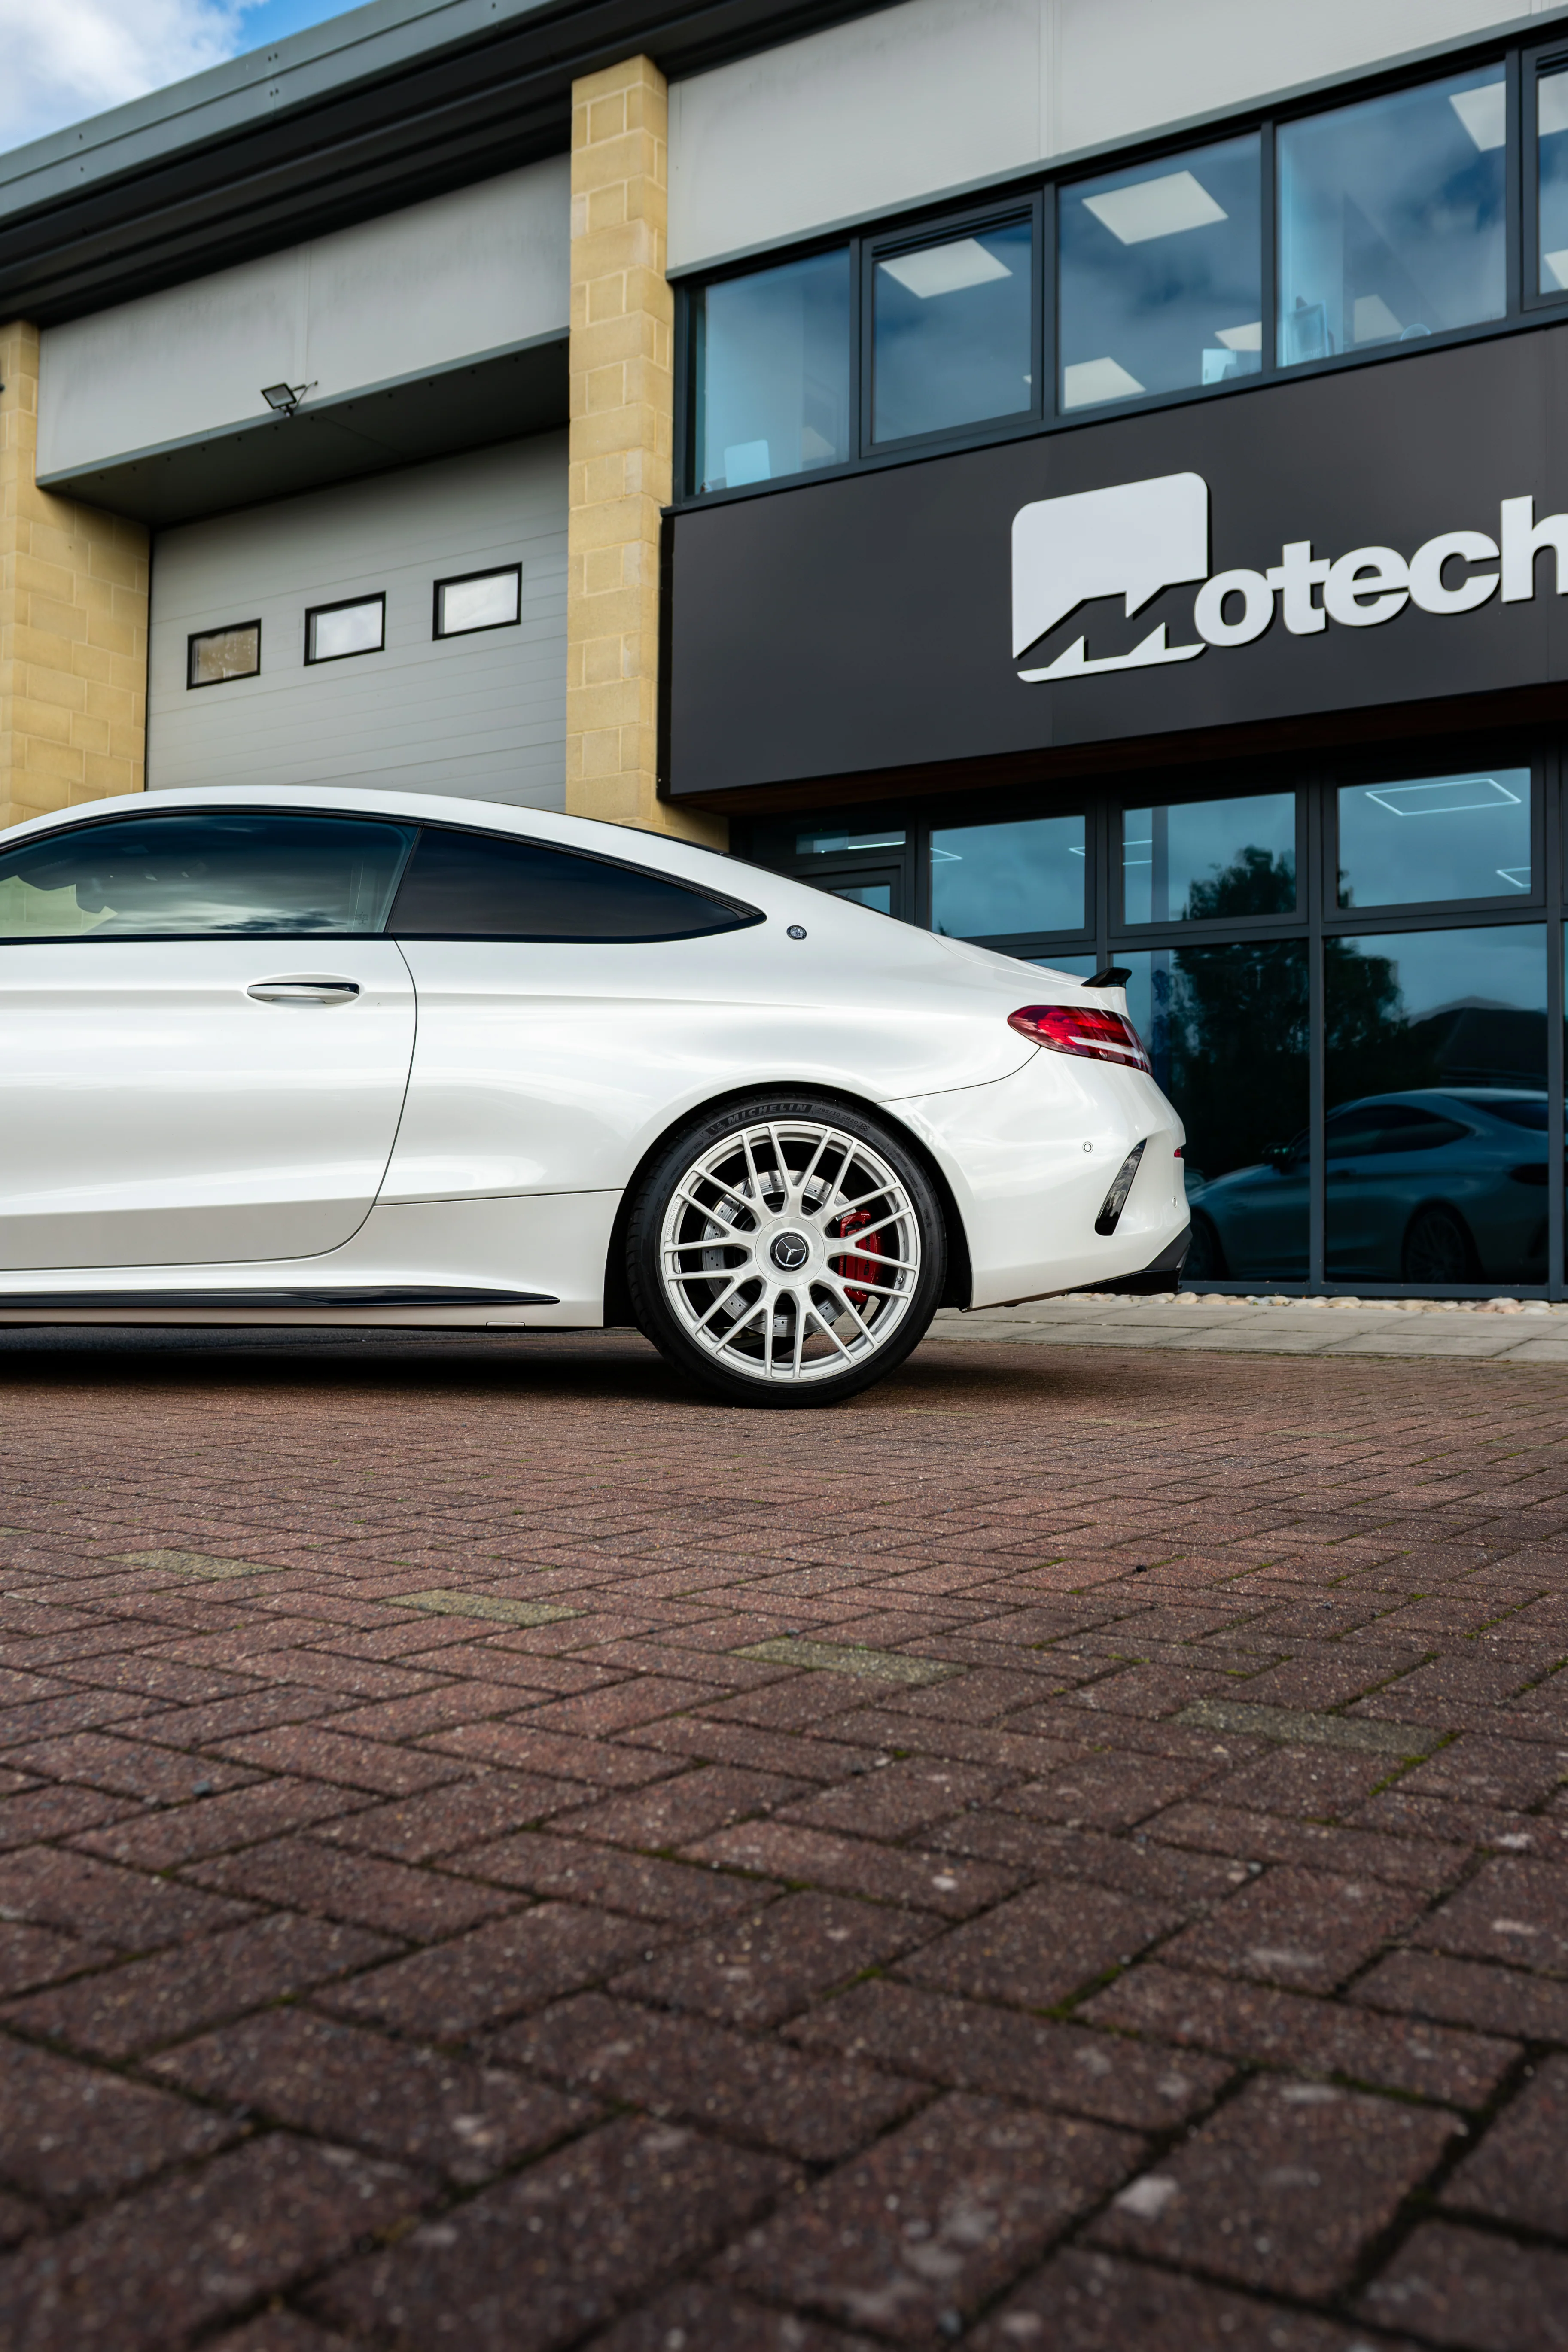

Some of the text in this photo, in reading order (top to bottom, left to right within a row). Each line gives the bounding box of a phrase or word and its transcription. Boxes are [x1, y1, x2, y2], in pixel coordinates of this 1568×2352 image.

[728, 1104, 807, 1124] MICHELIN
[818, 1107, 859, 1125] 285/30 ZR20
